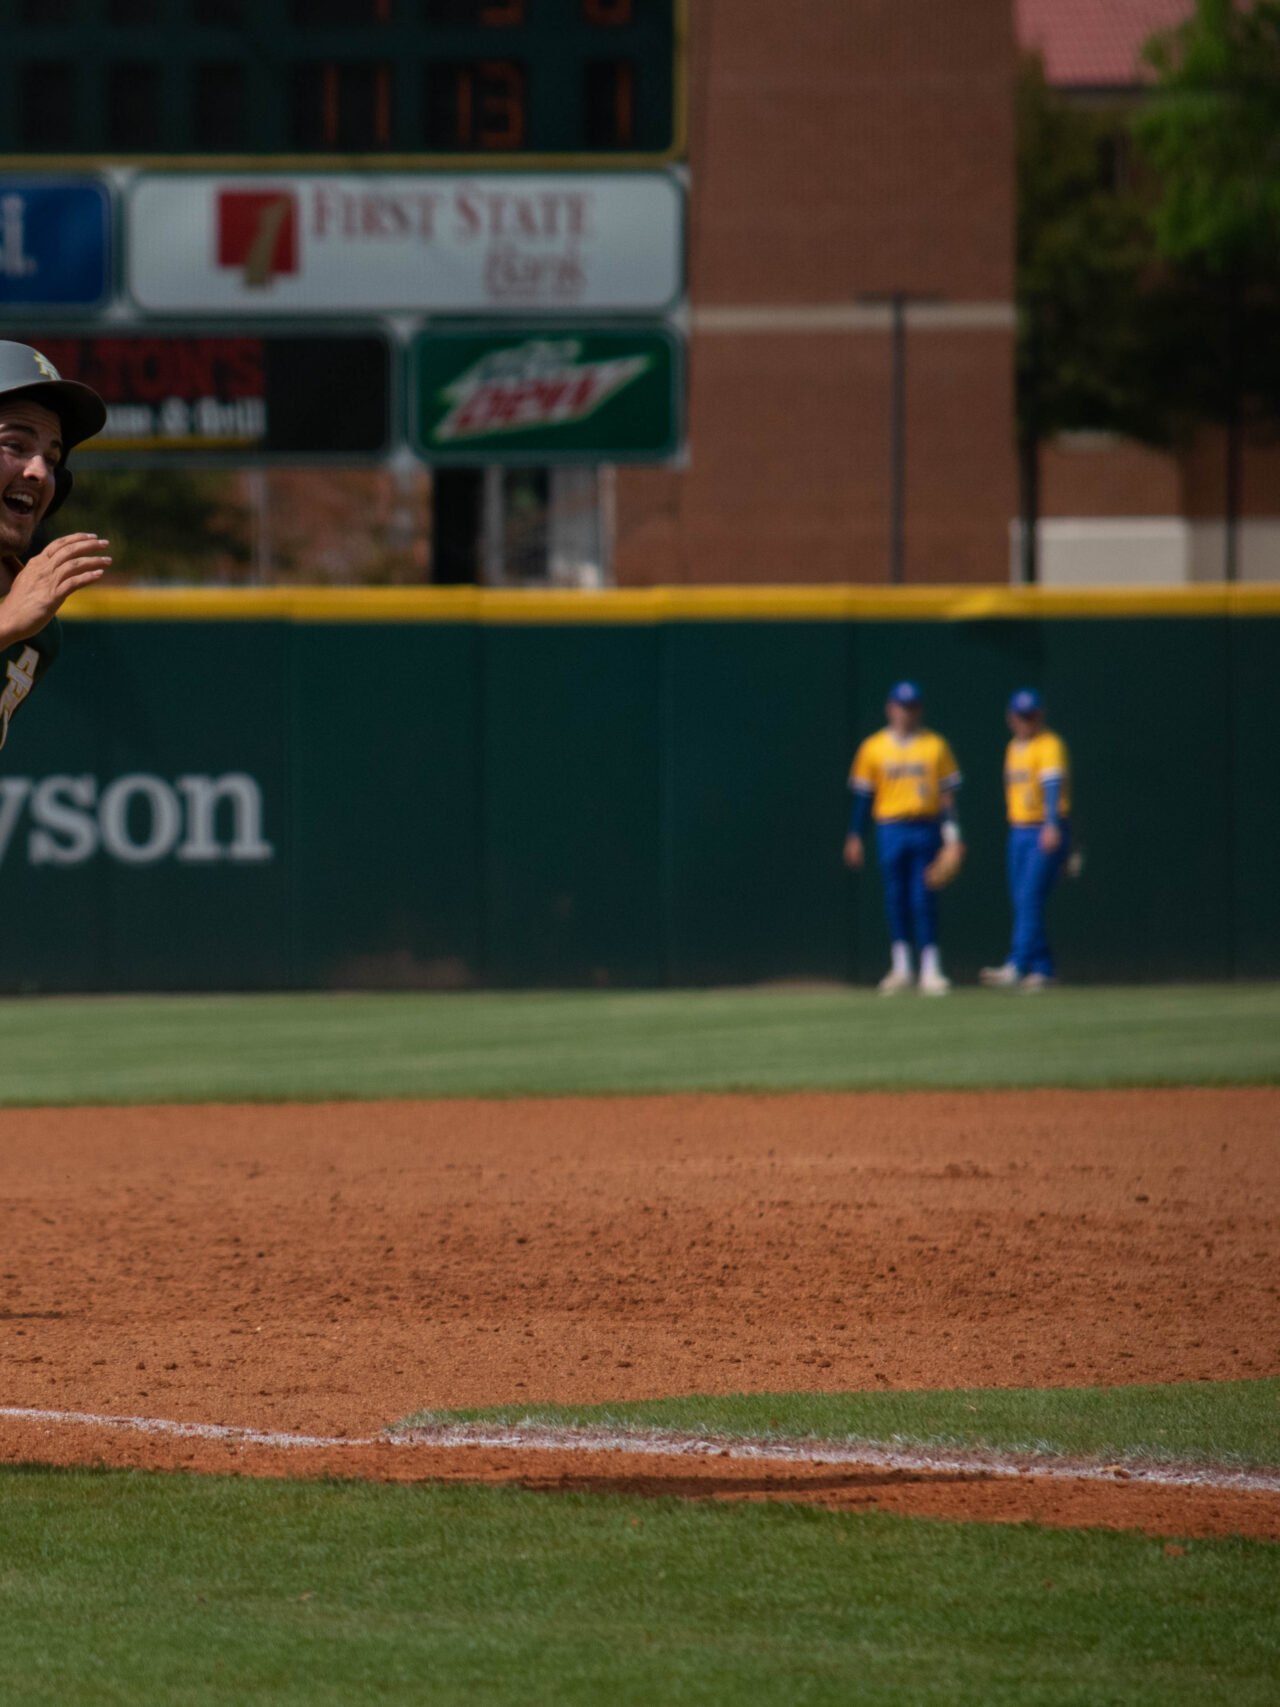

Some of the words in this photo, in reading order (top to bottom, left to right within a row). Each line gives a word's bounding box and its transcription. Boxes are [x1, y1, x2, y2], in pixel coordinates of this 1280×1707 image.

[320, 60, 391, 149] 11
[454, 60, 526, 150] 13
[613, 60, 634, 148] 1
[311, 183, 442, 240] FIRST
[452, 181, 590, 240] STATE
